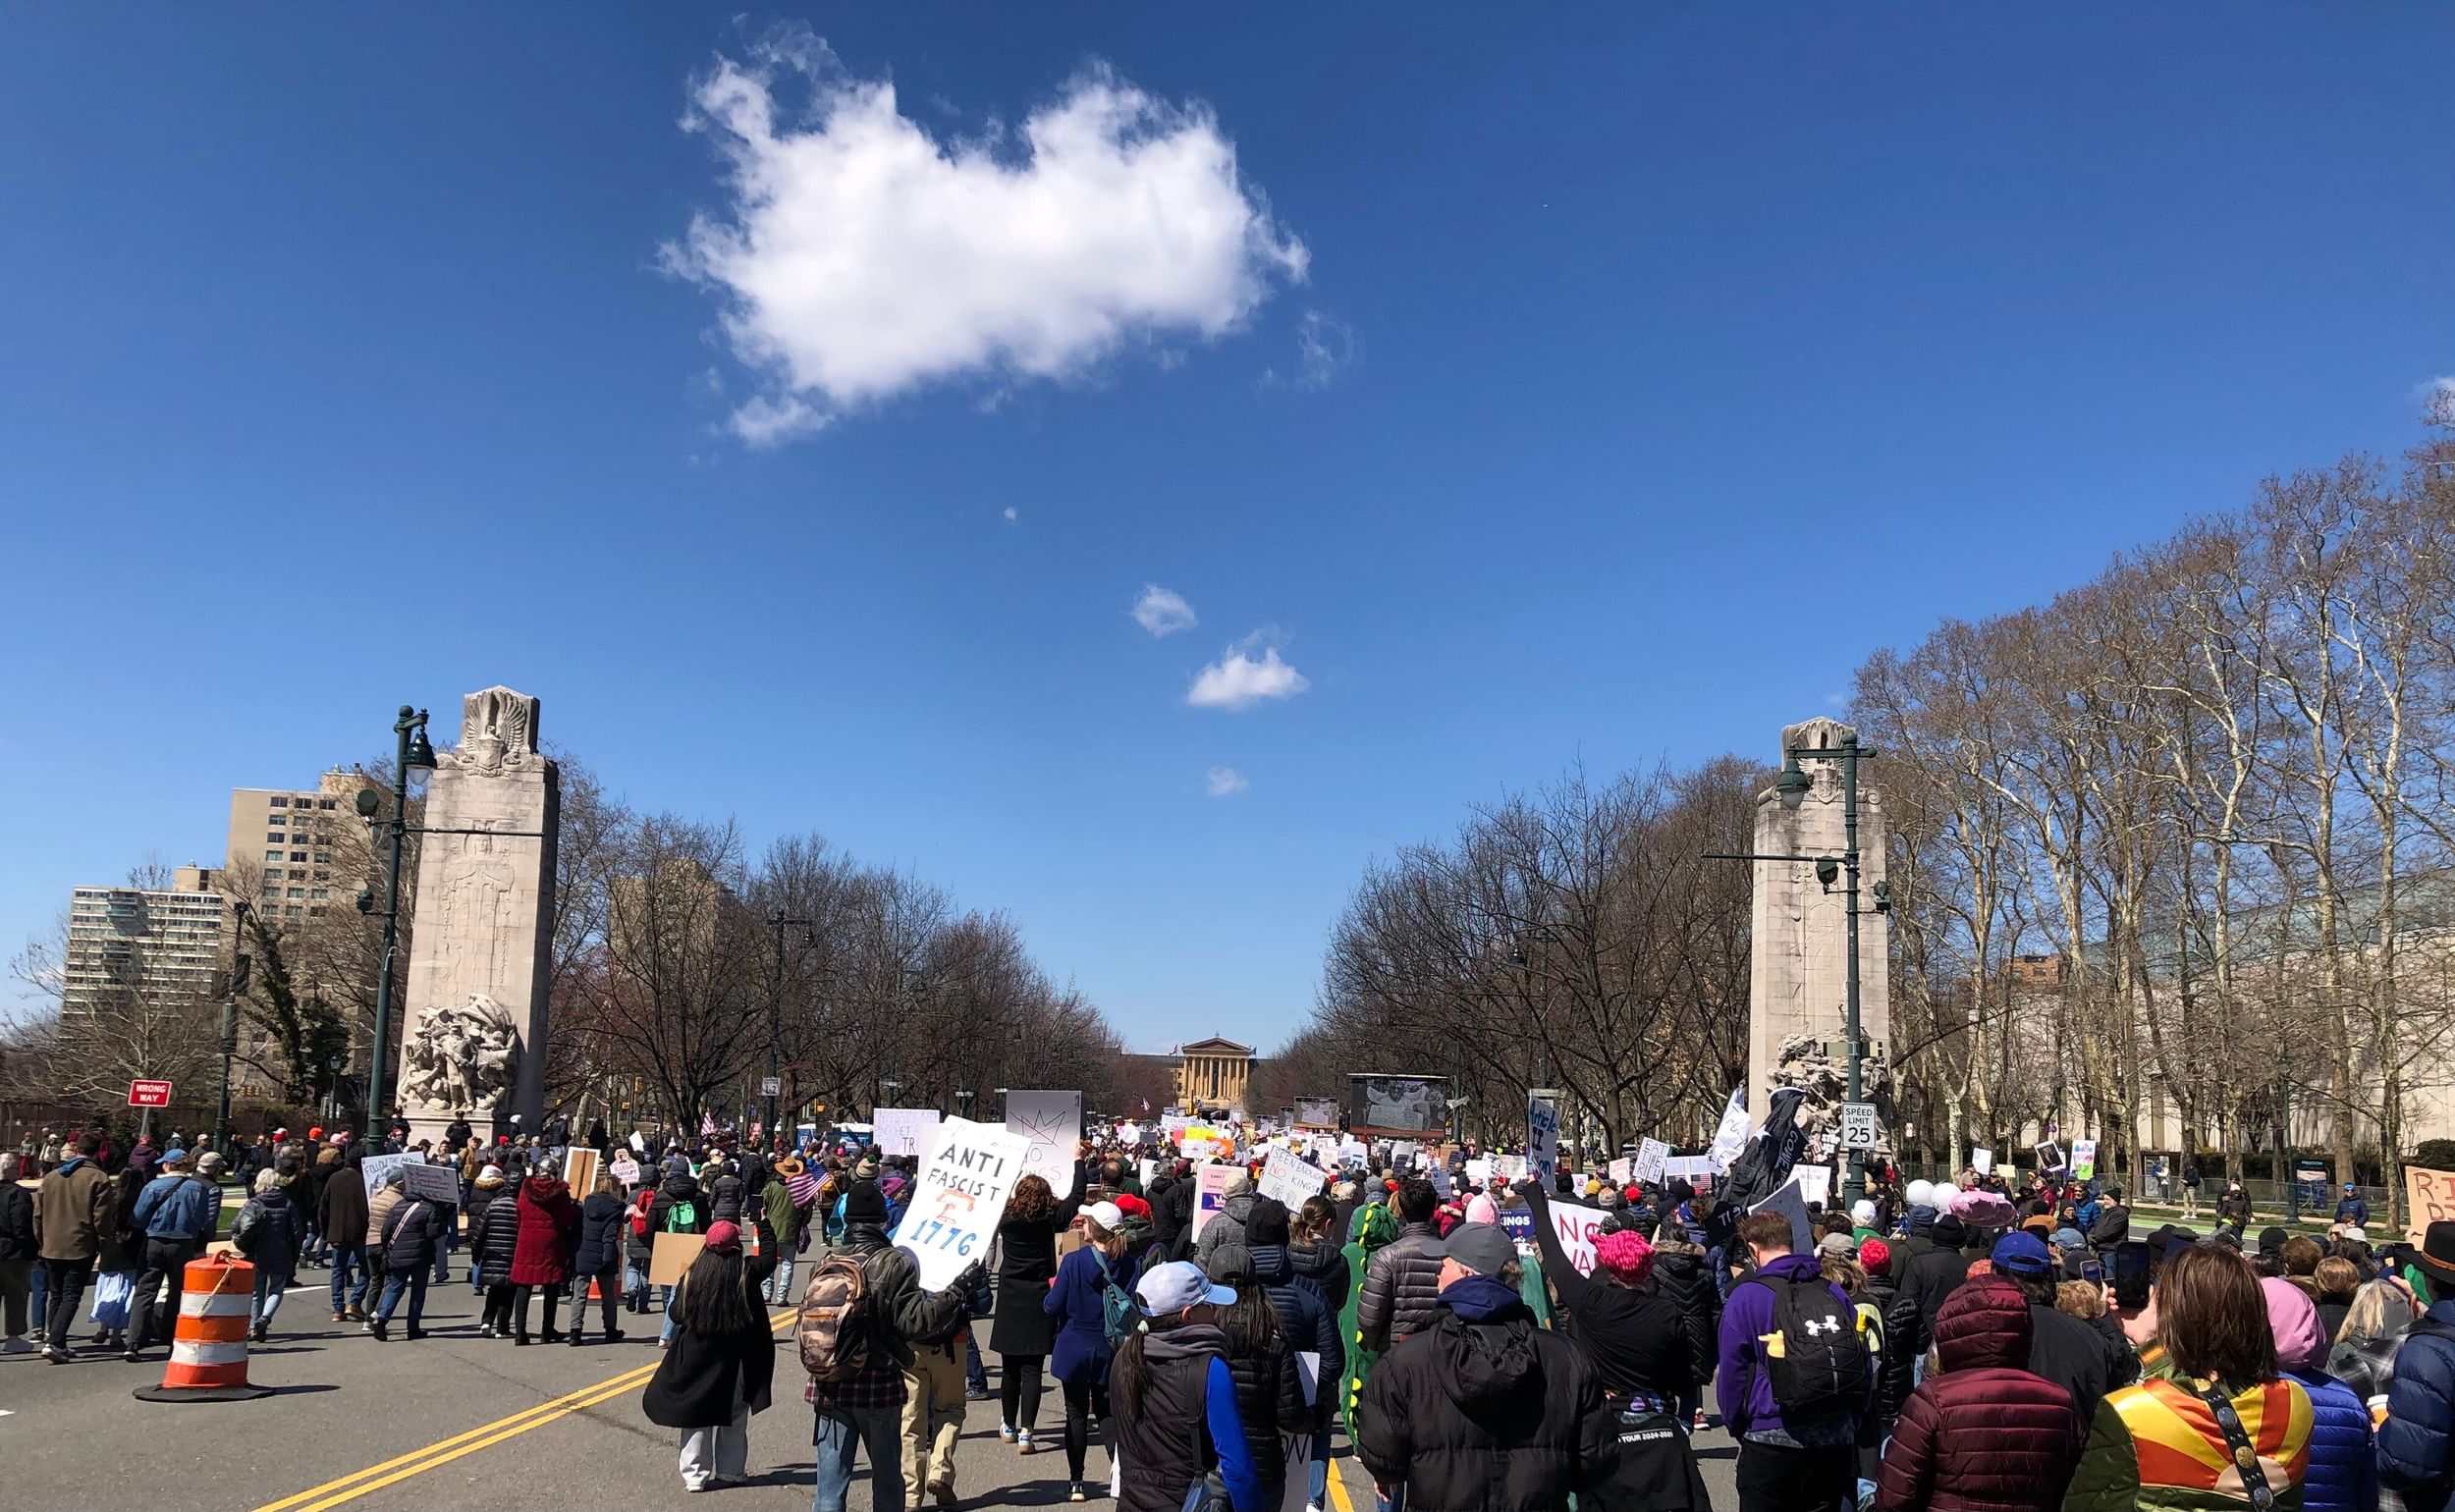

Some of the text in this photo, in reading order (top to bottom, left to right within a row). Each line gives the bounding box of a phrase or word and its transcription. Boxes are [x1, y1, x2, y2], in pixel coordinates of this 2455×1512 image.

[136, 1084, 167, 1093] WRONG
[1530, 1100, 1557, 1133] Article
[1845, 1107, 1873, 1116] SPEED
[1532, 1126, 1544, 1152] II
[1848, 1127, 1871, 1143] 25
[1644, 1140, 1667, 1156] EAT
[938, 1143, 1005, 1178] ANTI
[1272, 1148, 1296, 1168] SEEN
[1642, 1150, 1664, 1168] THE
[364, 1159, 387, 1177] FOLLOW
[1270, 1162, 1286, 1177] NO
[927, 1167, 1001, 1201] FASCIST
[909, 1218, 977, 1256] 1776
[1621, 1433, 1641, 1443] TOUR
